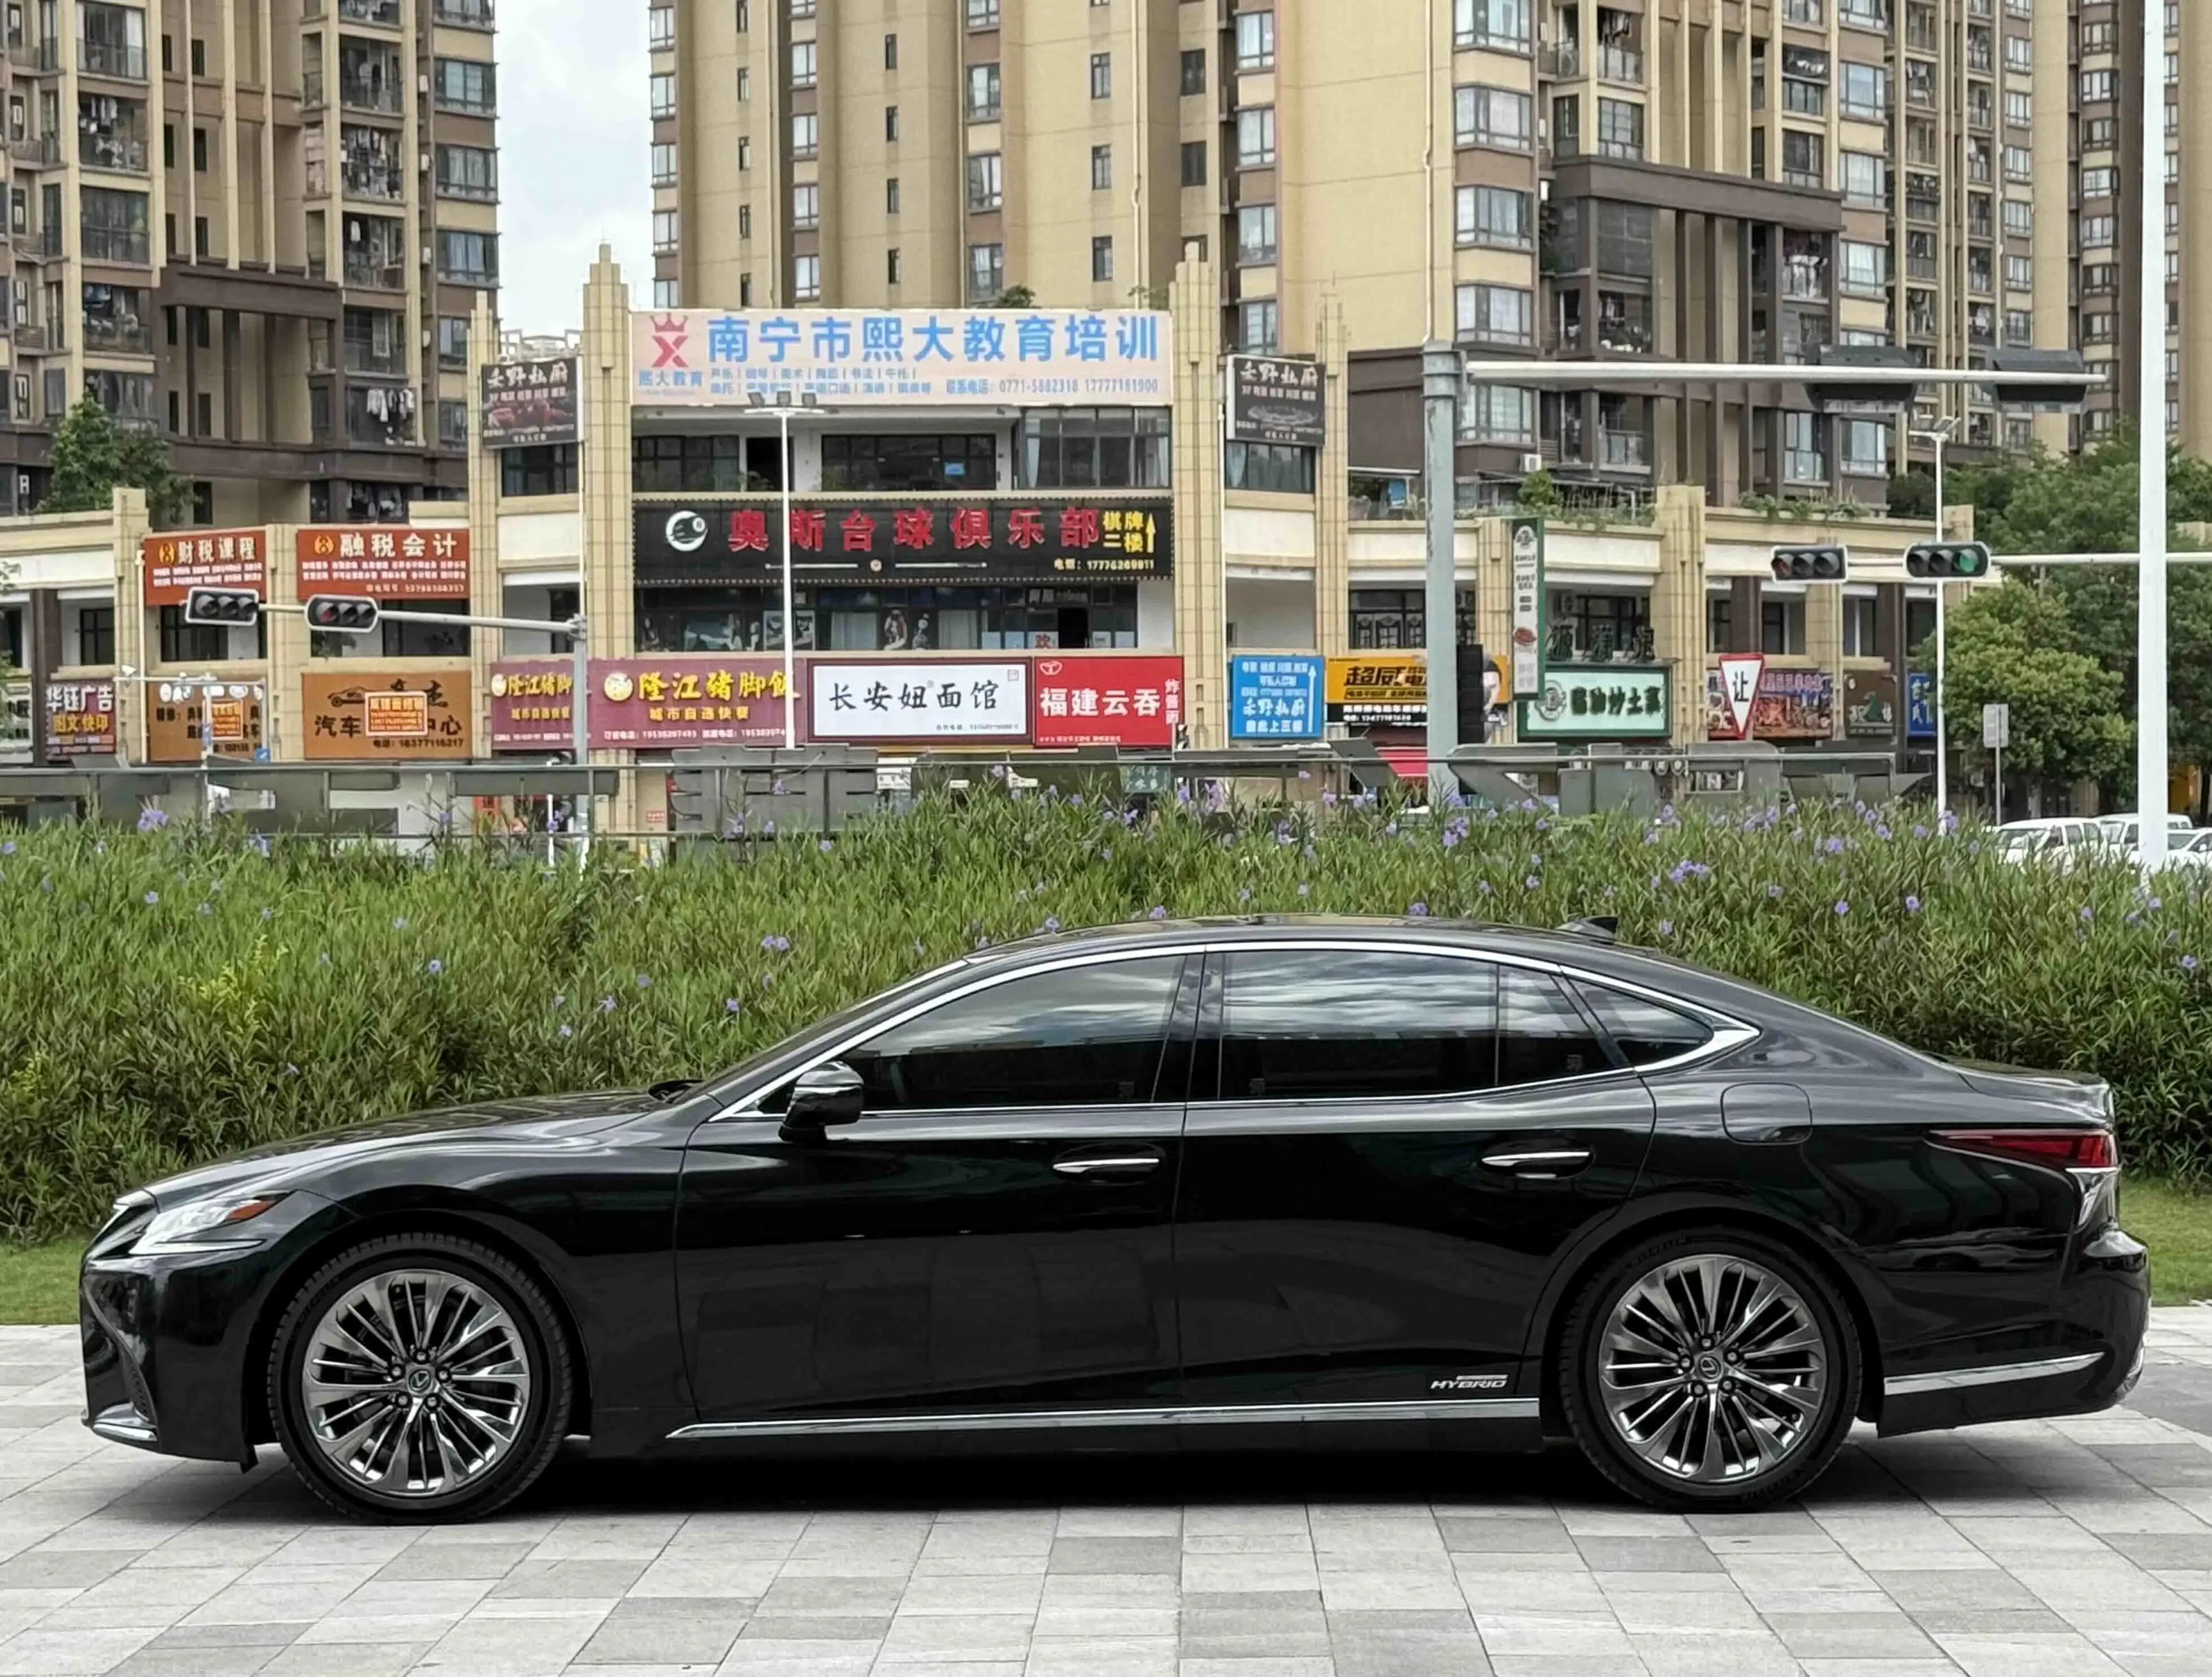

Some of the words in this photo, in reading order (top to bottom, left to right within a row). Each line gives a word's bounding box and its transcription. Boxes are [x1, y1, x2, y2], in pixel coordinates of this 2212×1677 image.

[707, 315, 1157, 363] 南宁市熙大教育培训
[727, 506, 1100, 552] 奥斯台球俱乐部
[829, 679, 999, 710] 长安妞面馆
[1732, 670, 1750, 702] 让
[1040, 687, 1160, 717] 福建云吞
[1430, 1379, 1508, 1389] HYBRID
